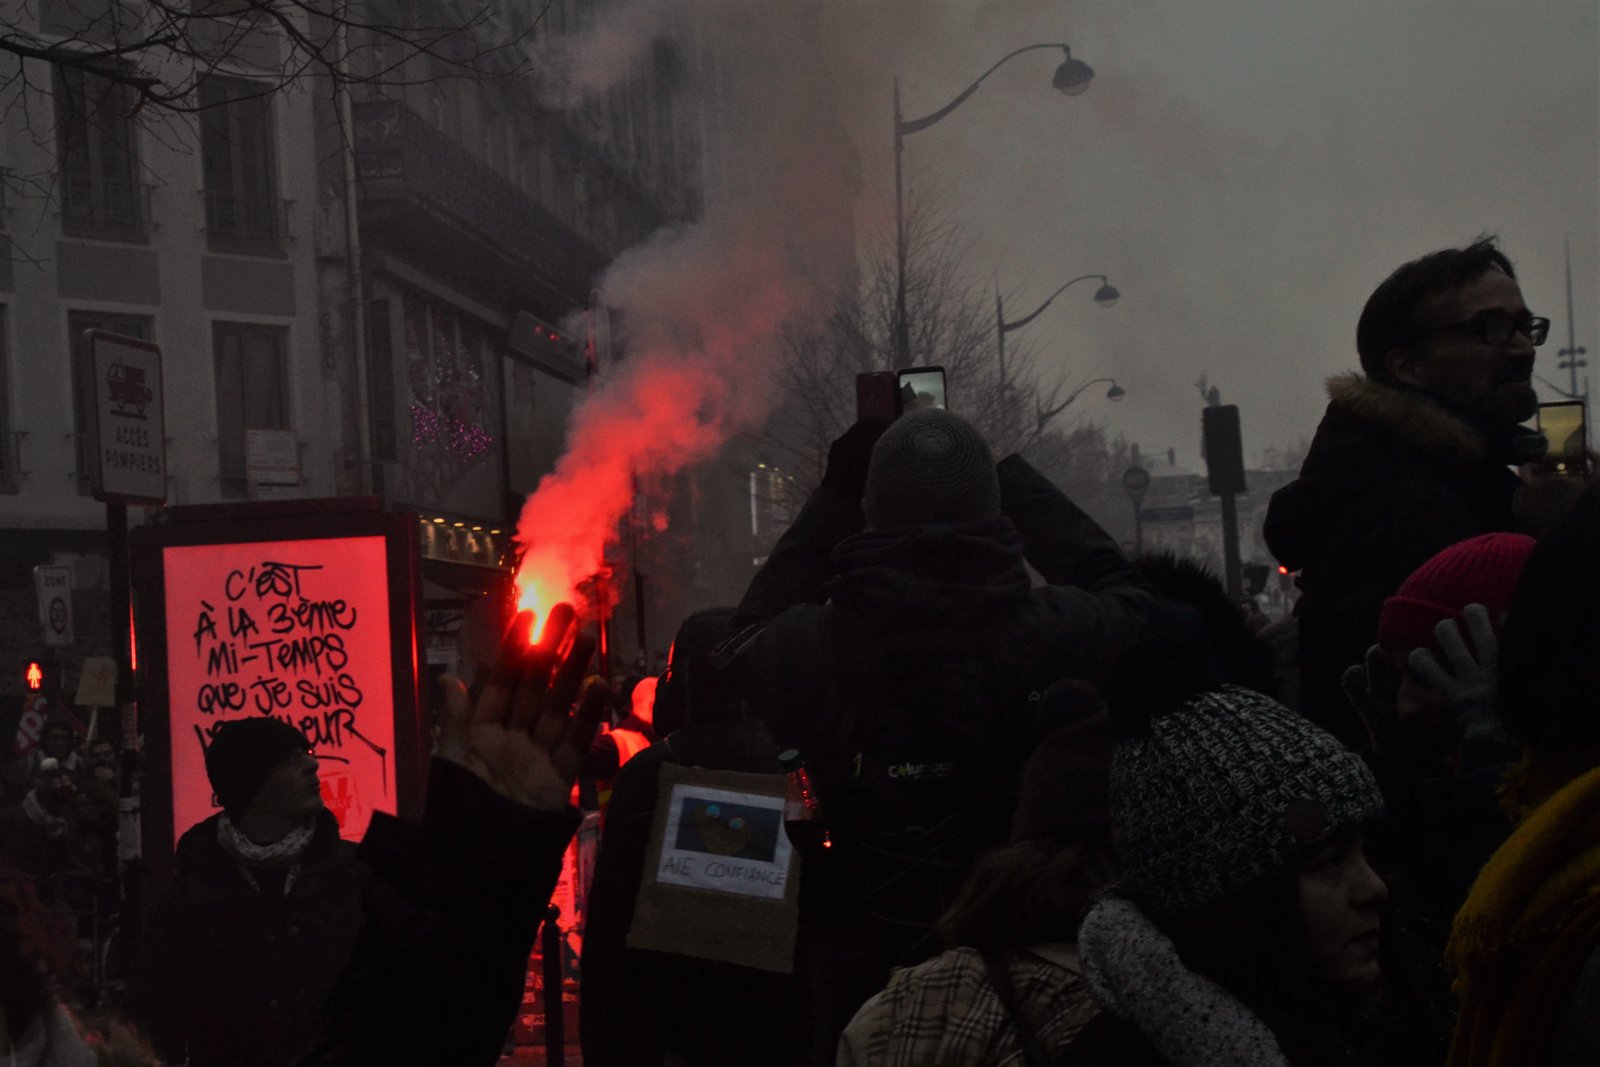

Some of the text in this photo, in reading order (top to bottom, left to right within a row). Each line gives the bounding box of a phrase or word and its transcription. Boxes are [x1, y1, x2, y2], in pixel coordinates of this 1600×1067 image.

[116, 425, 149, 447] ACCÈS
[105, 449, 160, 474] POMPIERS
[194, 596, 356, 657] À LA 3ème
[662, 856, 786, 885] AIE CONFIANCE
